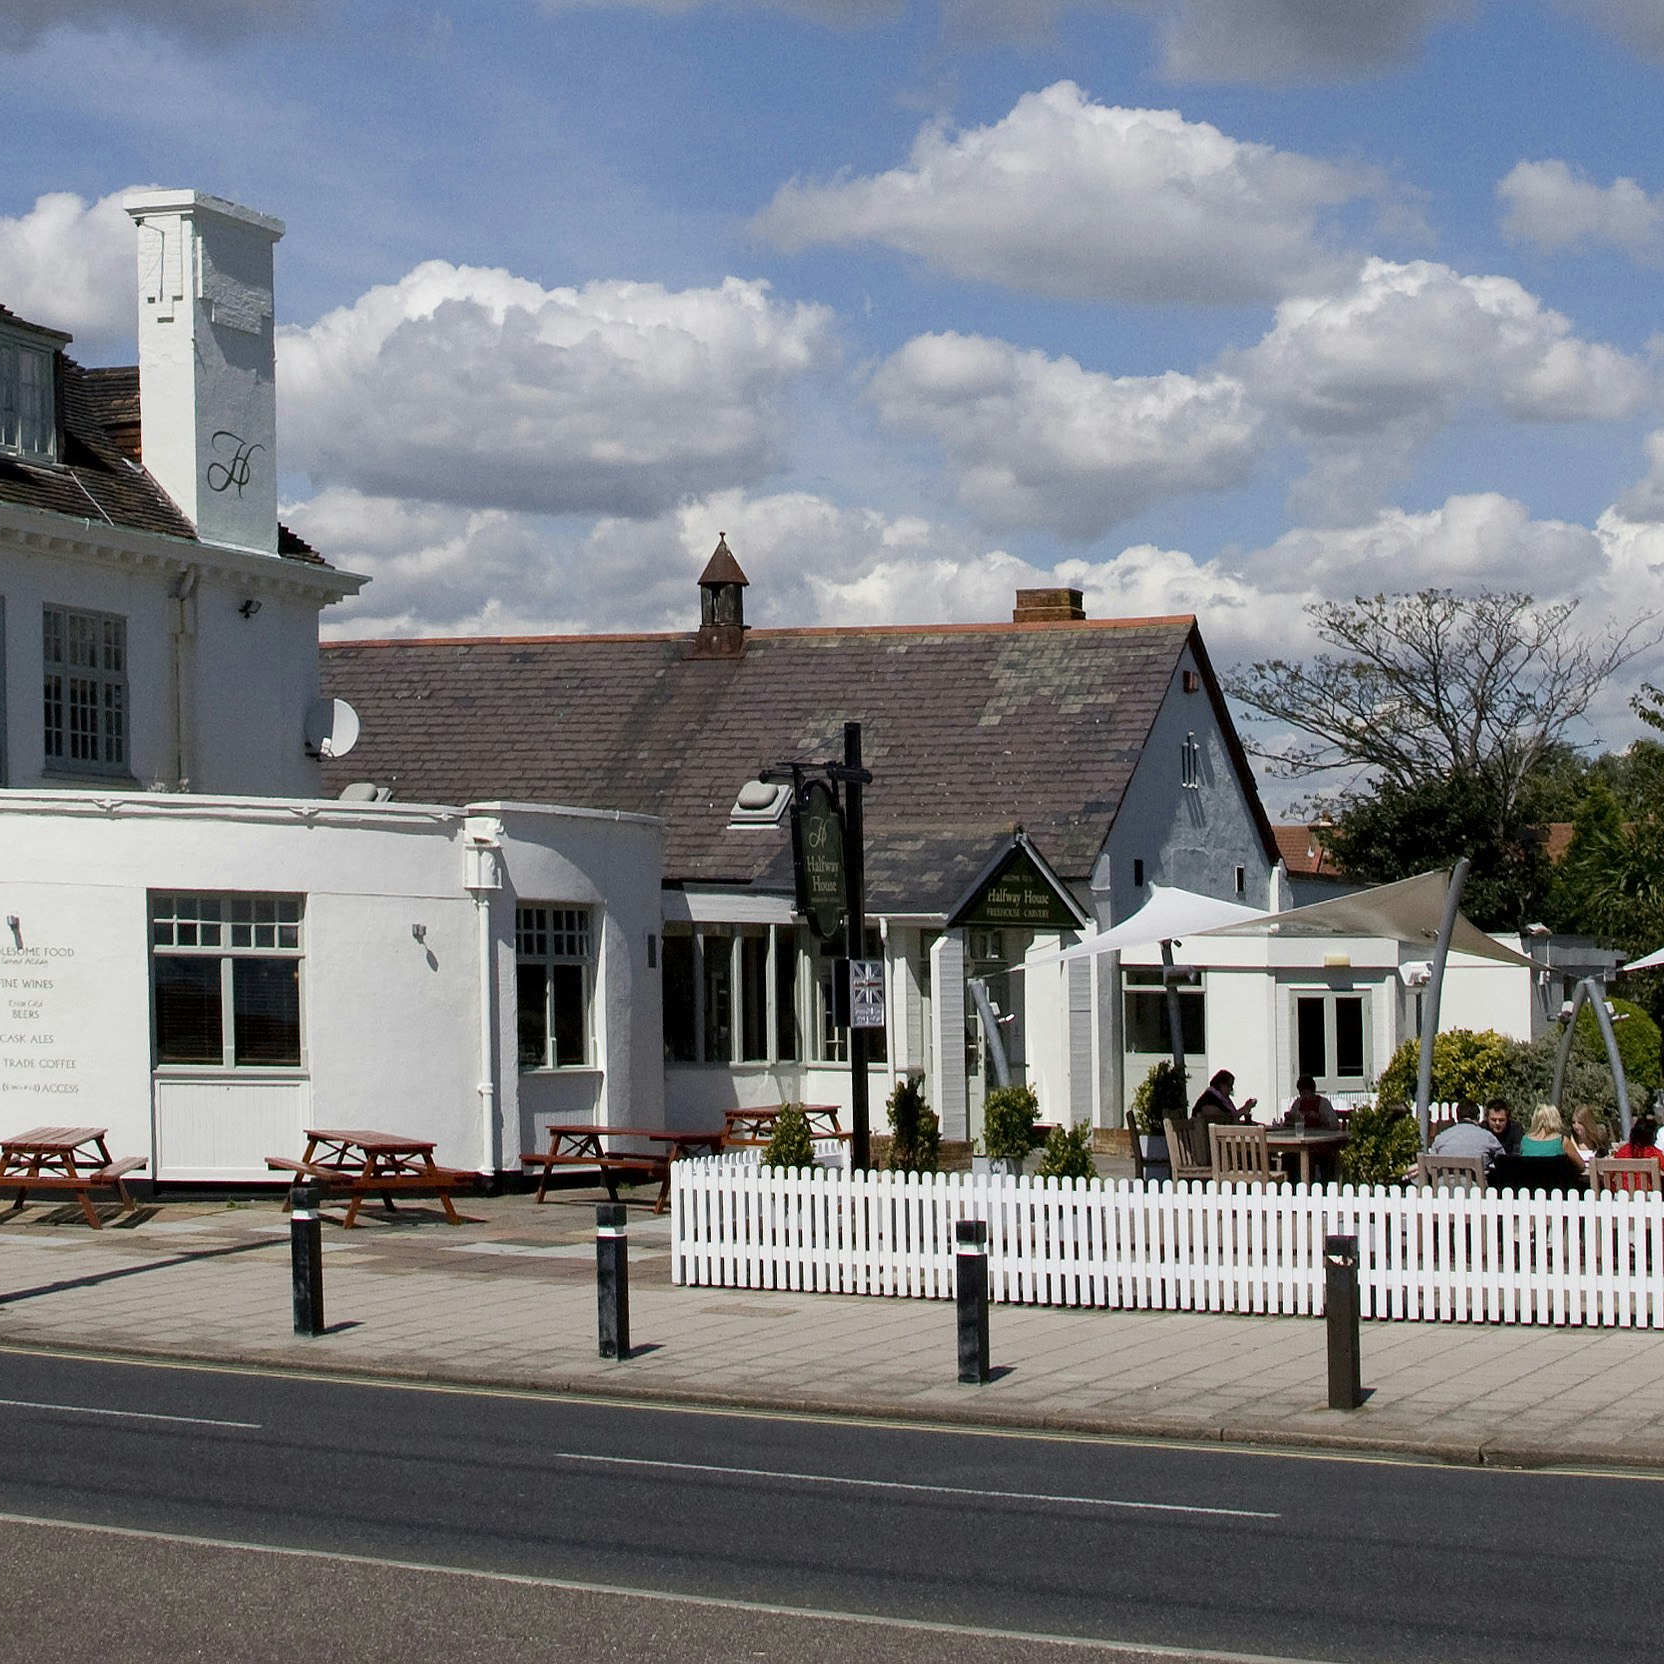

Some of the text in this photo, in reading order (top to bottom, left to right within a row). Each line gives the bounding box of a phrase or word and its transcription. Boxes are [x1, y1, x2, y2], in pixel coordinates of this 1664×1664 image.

[806, 854, 840, 878] Halfway
[812, 874, 837, 892] House
[987, 888, 1049, 907] Halfway House
[44, 947, 75, 957] FOOD
[22, 979, 54, 989] WINES
[12, 1009, 40, 1020] BEERS
[0, 1033, 55, 1045] CASK ALES
[3, 1058, 36, 1068] TRADE
[39, 1058, 78, 1069] COFFEE
[41, 1083, 79, 1094] ACCESS
